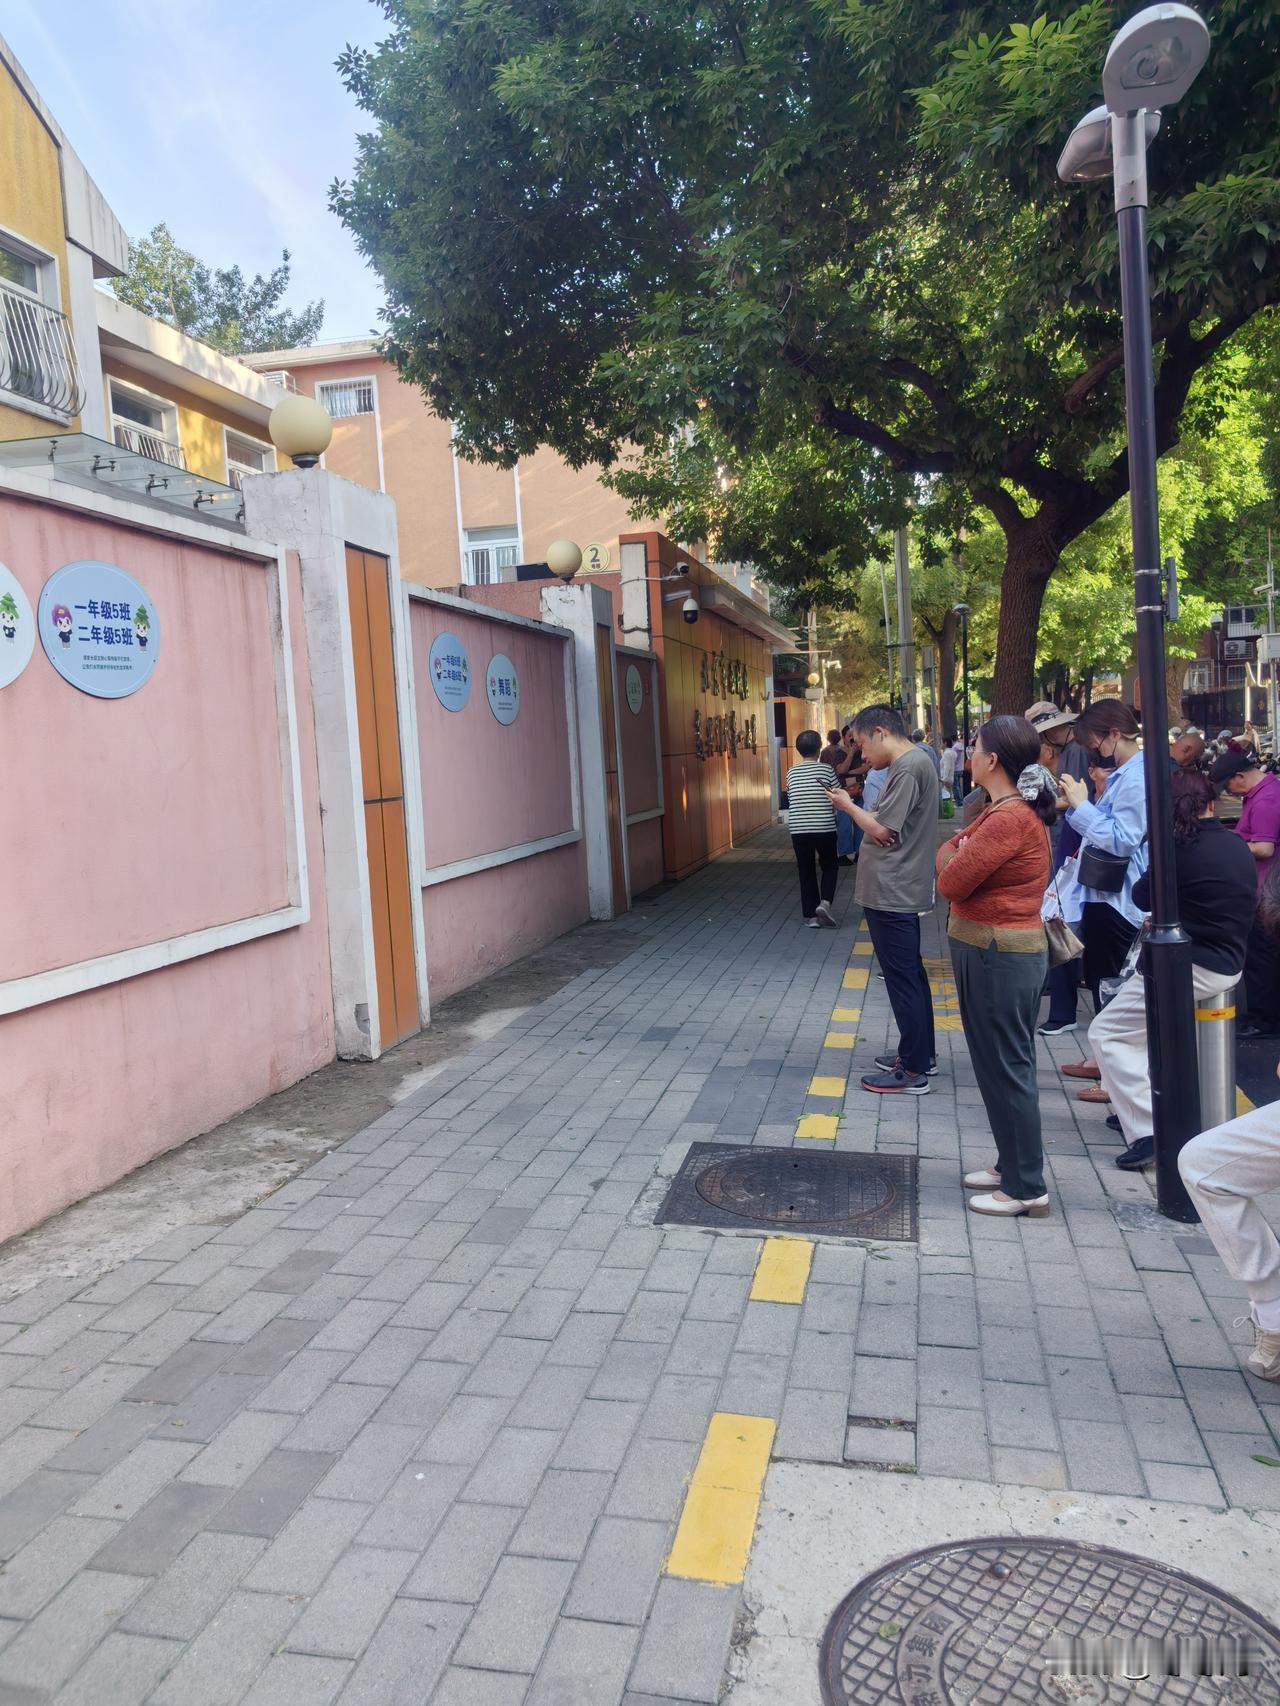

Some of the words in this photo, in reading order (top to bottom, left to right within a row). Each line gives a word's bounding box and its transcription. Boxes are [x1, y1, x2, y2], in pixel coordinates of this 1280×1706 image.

[590, 547, 600, 563] 2
[74, 600, 131, 621] 一年级5班
[78, 625, 133, 645] 二年级5班
